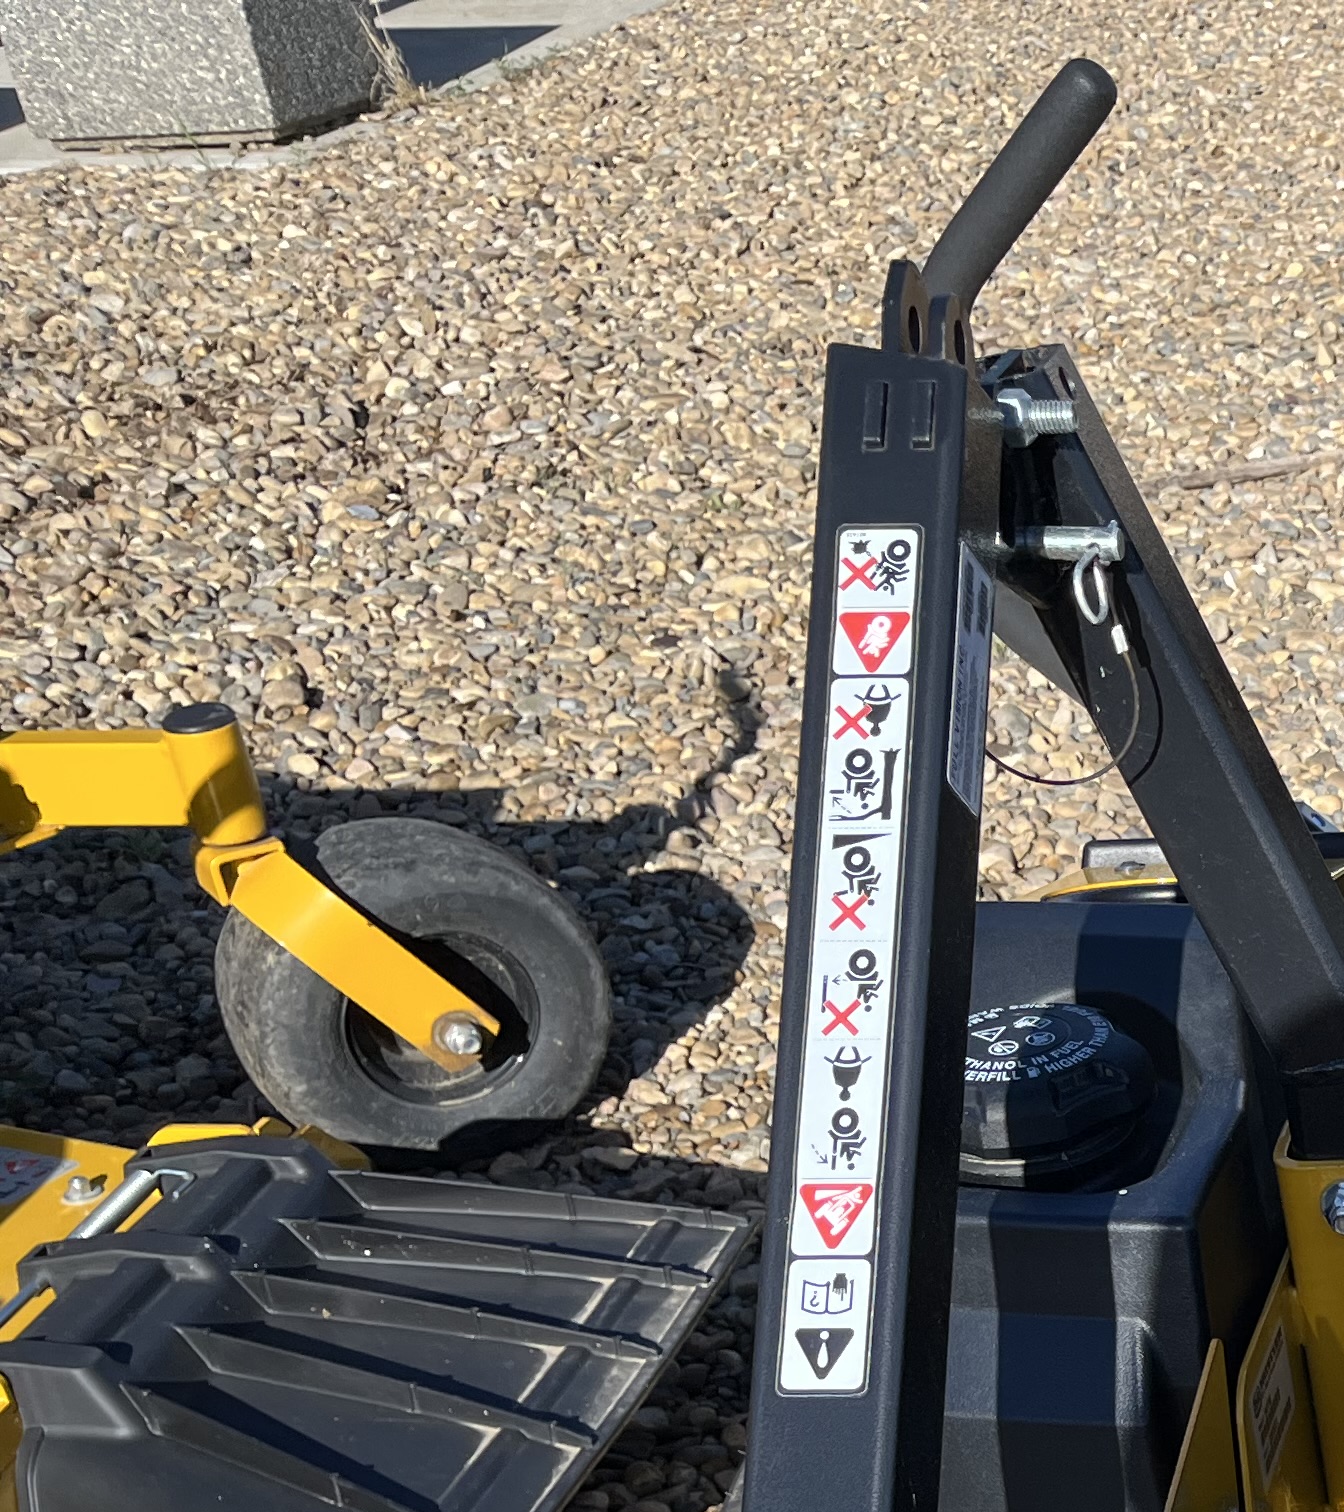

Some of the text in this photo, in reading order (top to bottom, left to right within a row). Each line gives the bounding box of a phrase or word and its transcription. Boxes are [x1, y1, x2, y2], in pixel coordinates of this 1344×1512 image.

[965, 1040, 1084, 1070] THANOL IN FUEL
[1044, 1046, 1097, 1073] HIGHER
